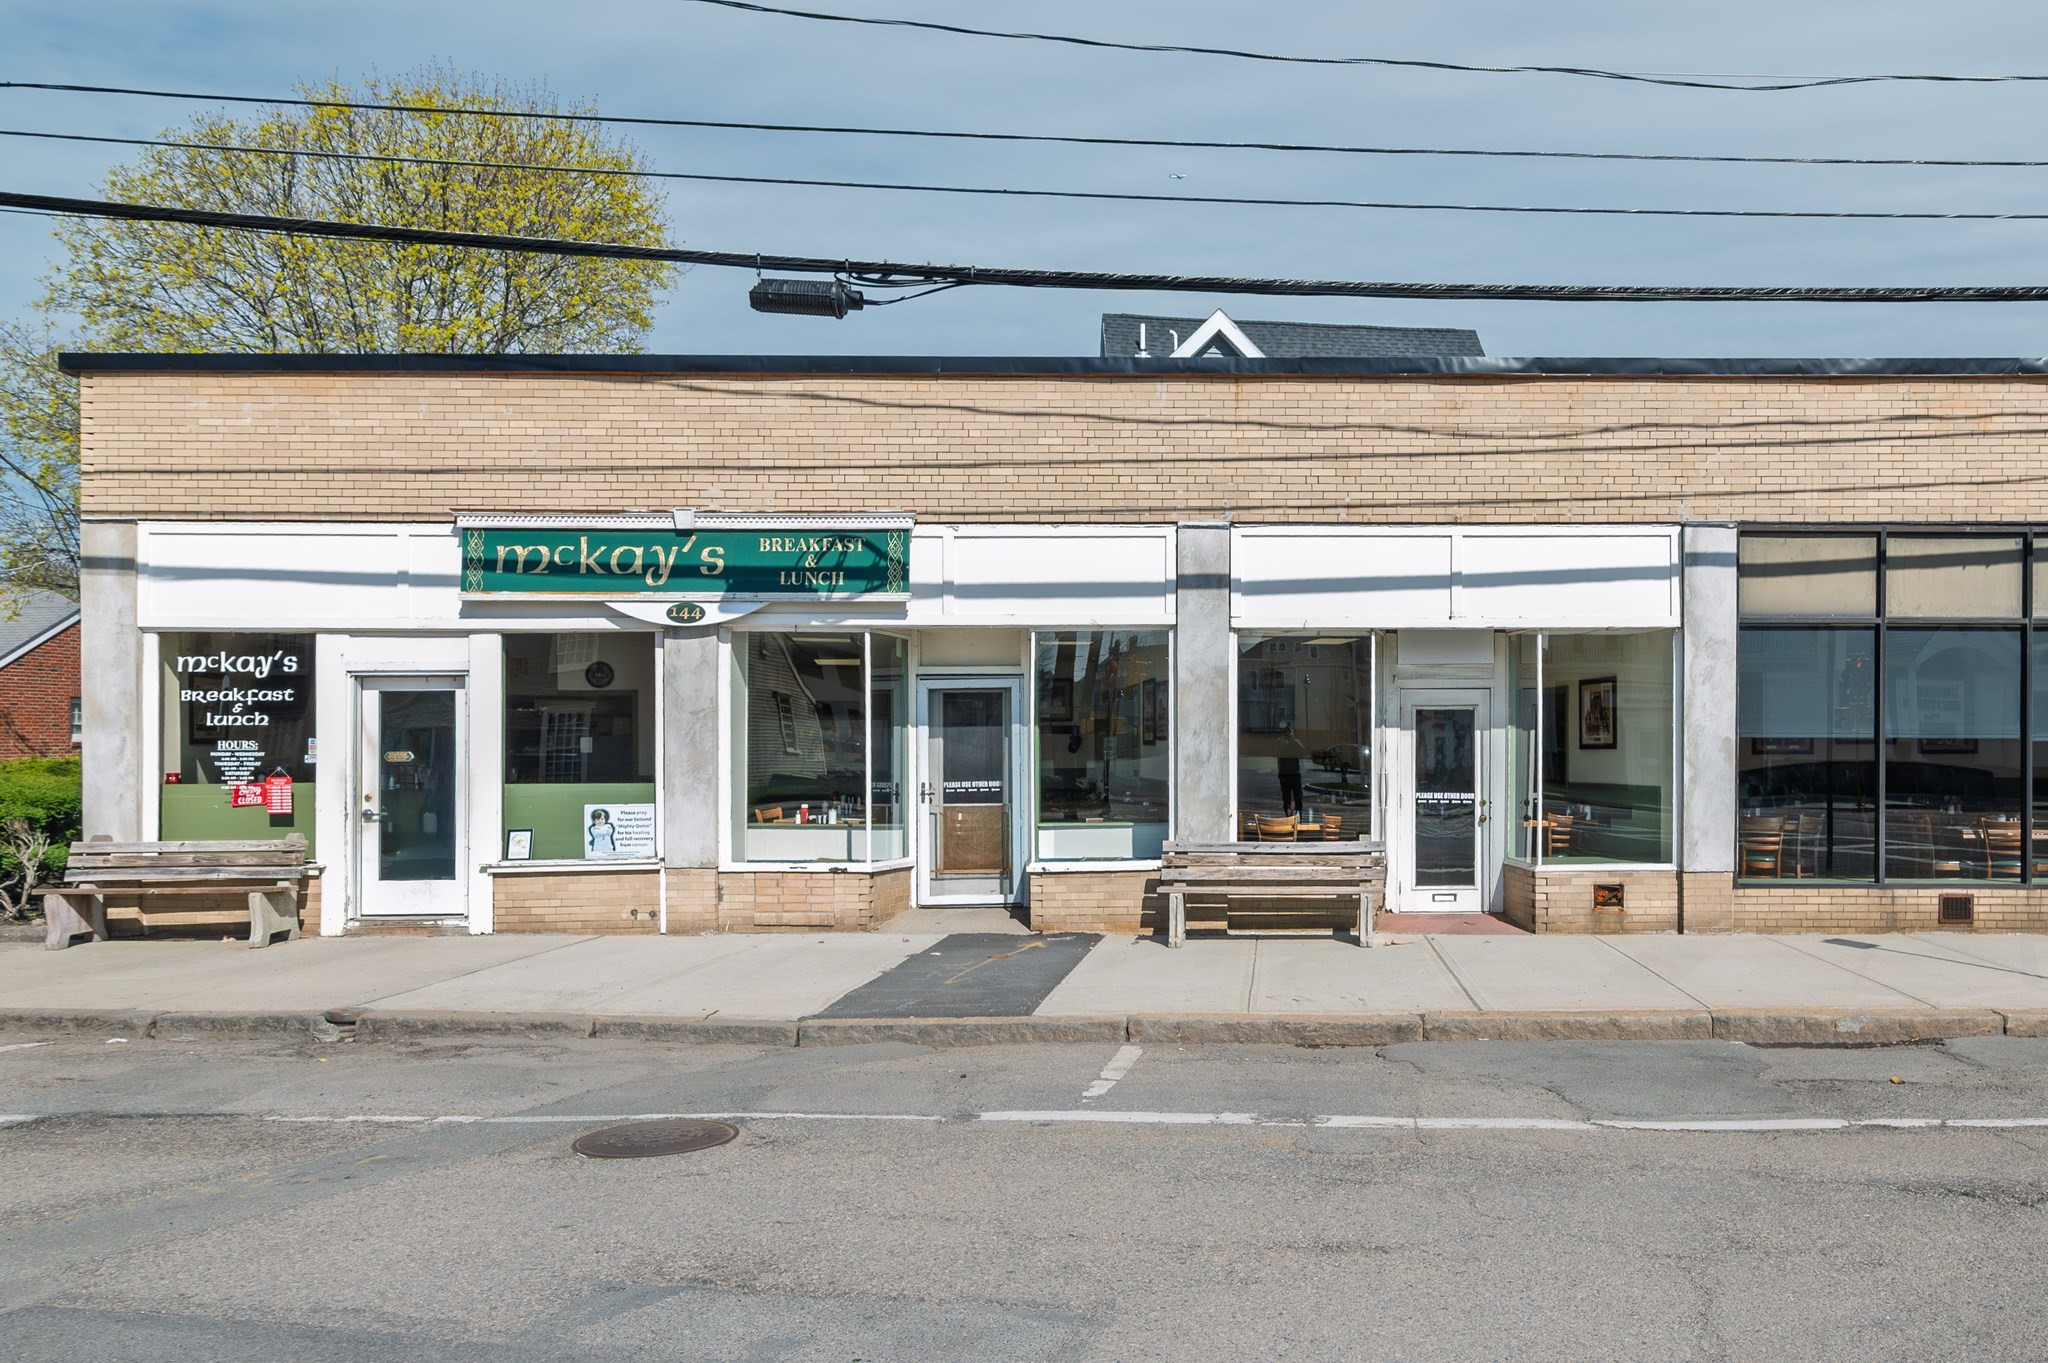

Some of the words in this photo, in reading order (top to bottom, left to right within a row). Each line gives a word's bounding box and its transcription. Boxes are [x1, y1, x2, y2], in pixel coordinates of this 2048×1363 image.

[759, 537, 866, 552] BREAKFAST
[804, 554, 817, 568] &
[780, 571, 845, 585] LUNCH
[670, 607, 702, 619] 144
[232, 703, 243, 713] &
[217, 740, 258, 750] HOURS:
[238, 796, 262, 804] CLOSED
